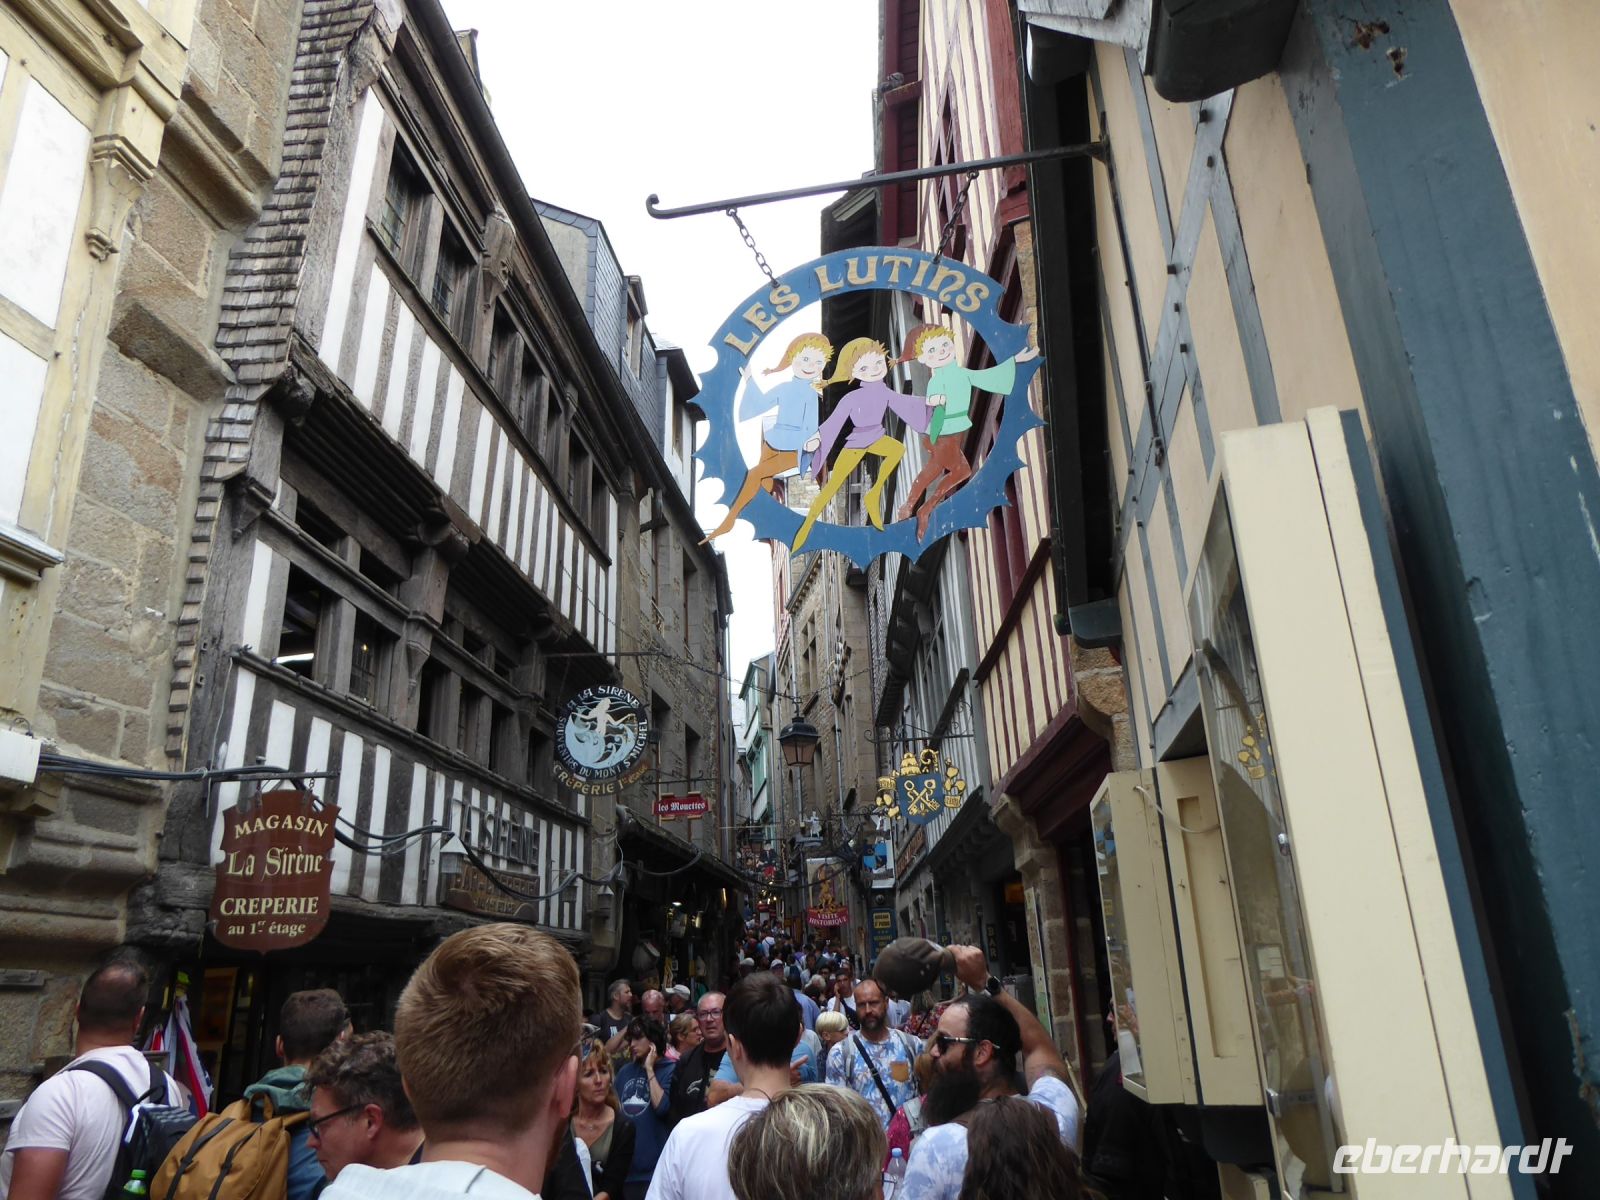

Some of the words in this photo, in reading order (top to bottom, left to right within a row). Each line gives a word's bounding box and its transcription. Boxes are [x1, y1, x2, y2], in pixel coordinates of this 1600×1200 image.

[723, 284, 800, 356] LES
[578, 689, 593, 701] LA
[555, 717, 578, 770] SOUVENIRS
[579, 766, 592, 777] DU
[594, 764, 622, 779] MONT
[630, 718, 648, 759] MICHEL
[235, 814, 329, 840] MAGASIN
[227, 850, 256, 877] La
[261, 846, 323, 882] Sirène
[220, 896, 319, 917] CREPERIE
[817, 912, 839, 920] VISITE
[227, 924, 245, 936] au
[268, 921, 307, 937] étage
